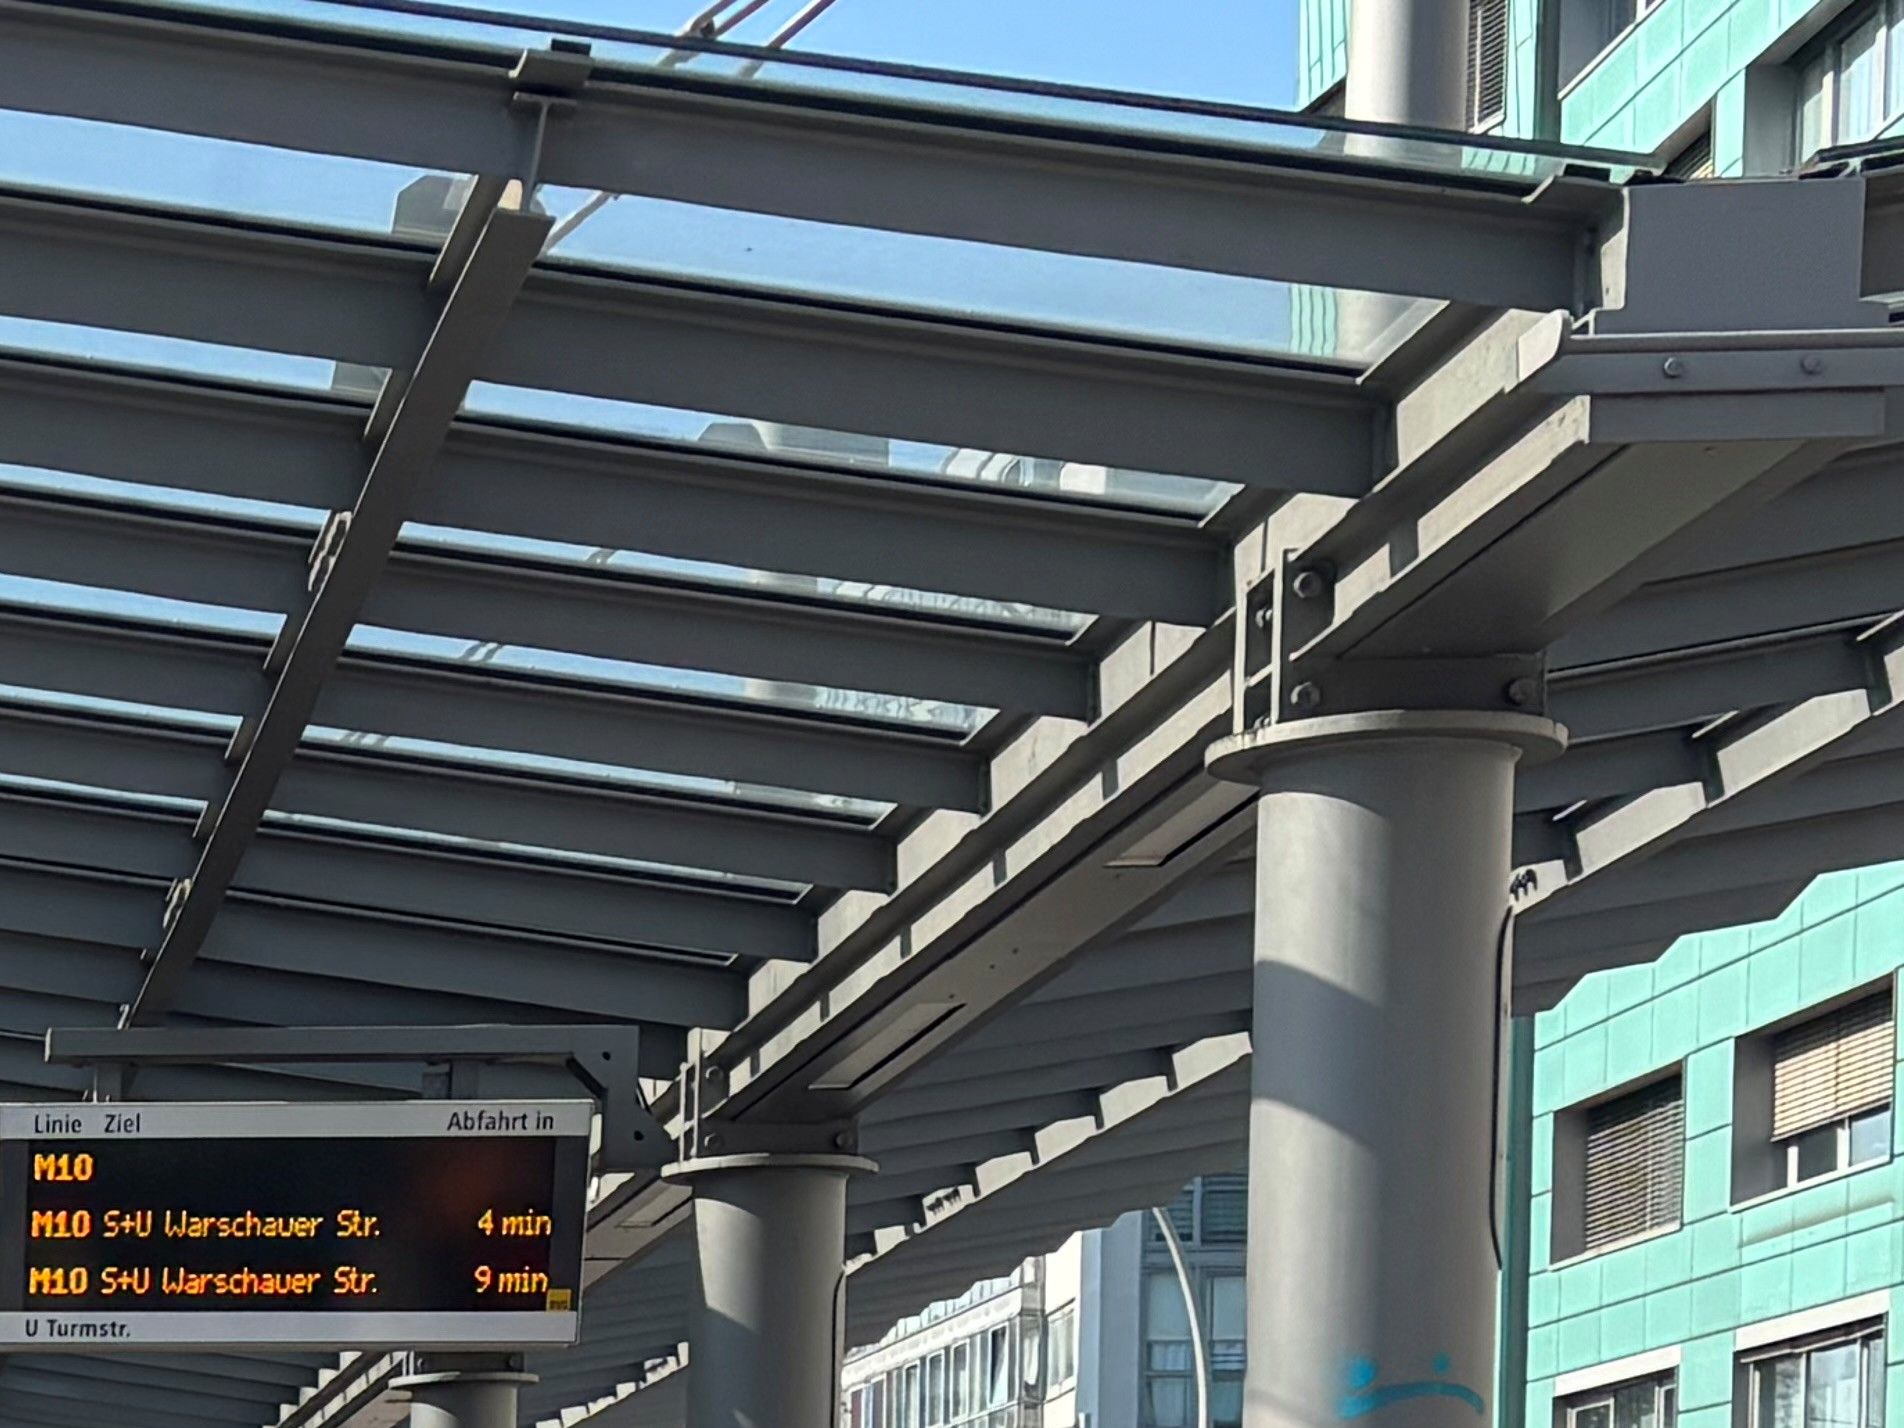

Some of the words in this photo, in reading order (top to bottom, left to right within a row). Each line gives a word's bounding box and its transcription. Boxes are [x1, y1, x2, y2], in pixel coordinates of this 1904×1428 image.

[34, 1114, 82, 1133] Linie
[104, 1113, 141, 1133] Ziel
[447, 1111, 527, 1131] Abfahrt
[536, 1111, 554, 1130] in
[34, 1153, 93, 1181] M10
[31, 1210, 91, 1238] M10
[103, 1210, 152, 1237] S+U
[164, 1210, 323, 1237] Warschauer
[336, 1209, 380, 1237] Str.
[478, 1209, 493, 1235] 4
[501, 1209, 552, 1236] min
[29, 1267, 88, 1295] M10
[101, 1267, 150, 1294] S+U
[162, 1266, 321, 1294] Warschauer
[334, 1266, 378, 1294] Str.
[475, 1265, 490, 1293] 9
[498, 1266, 548, 1293] min
[26, 1319, 38, 1337] U
[48, 1319, 130, 1338] Turmstr.
